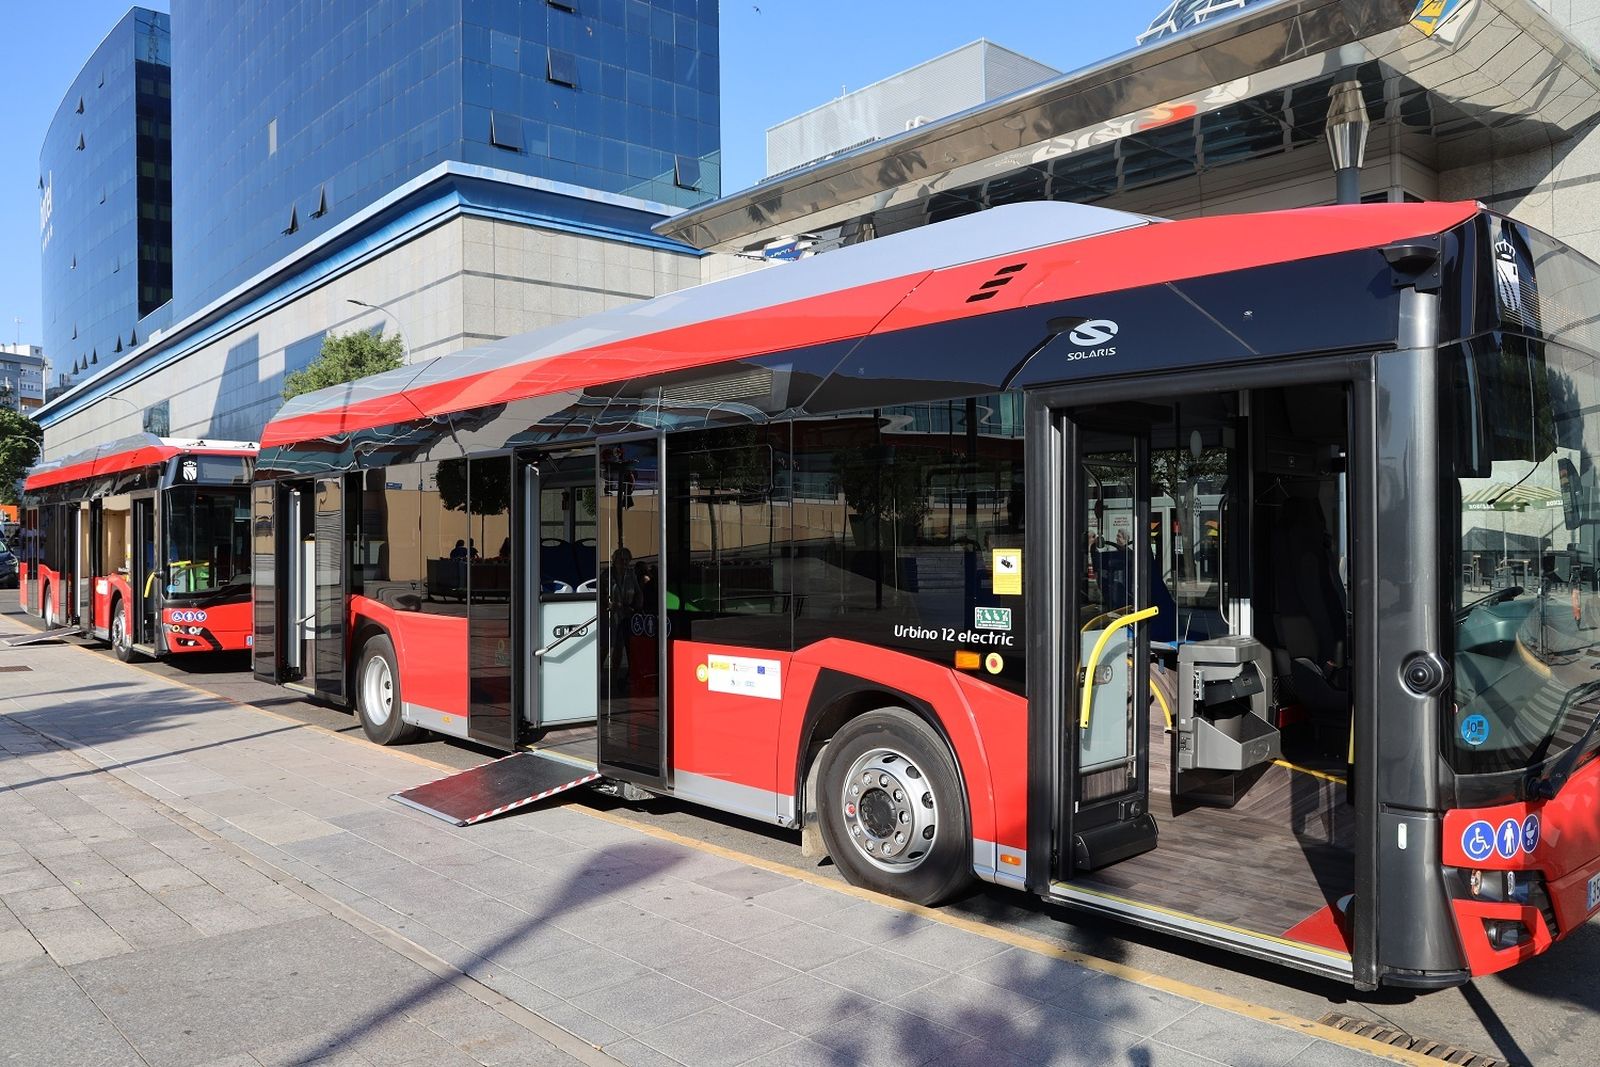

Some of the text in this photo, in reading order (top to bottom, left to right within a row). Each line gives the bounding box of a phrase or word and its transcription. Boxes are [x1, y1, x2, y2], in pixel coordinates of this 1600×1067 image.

[1067, 347, 1117, 361] SOLARIS
[894, 625, 1014, 646] Urbino 12 electric
